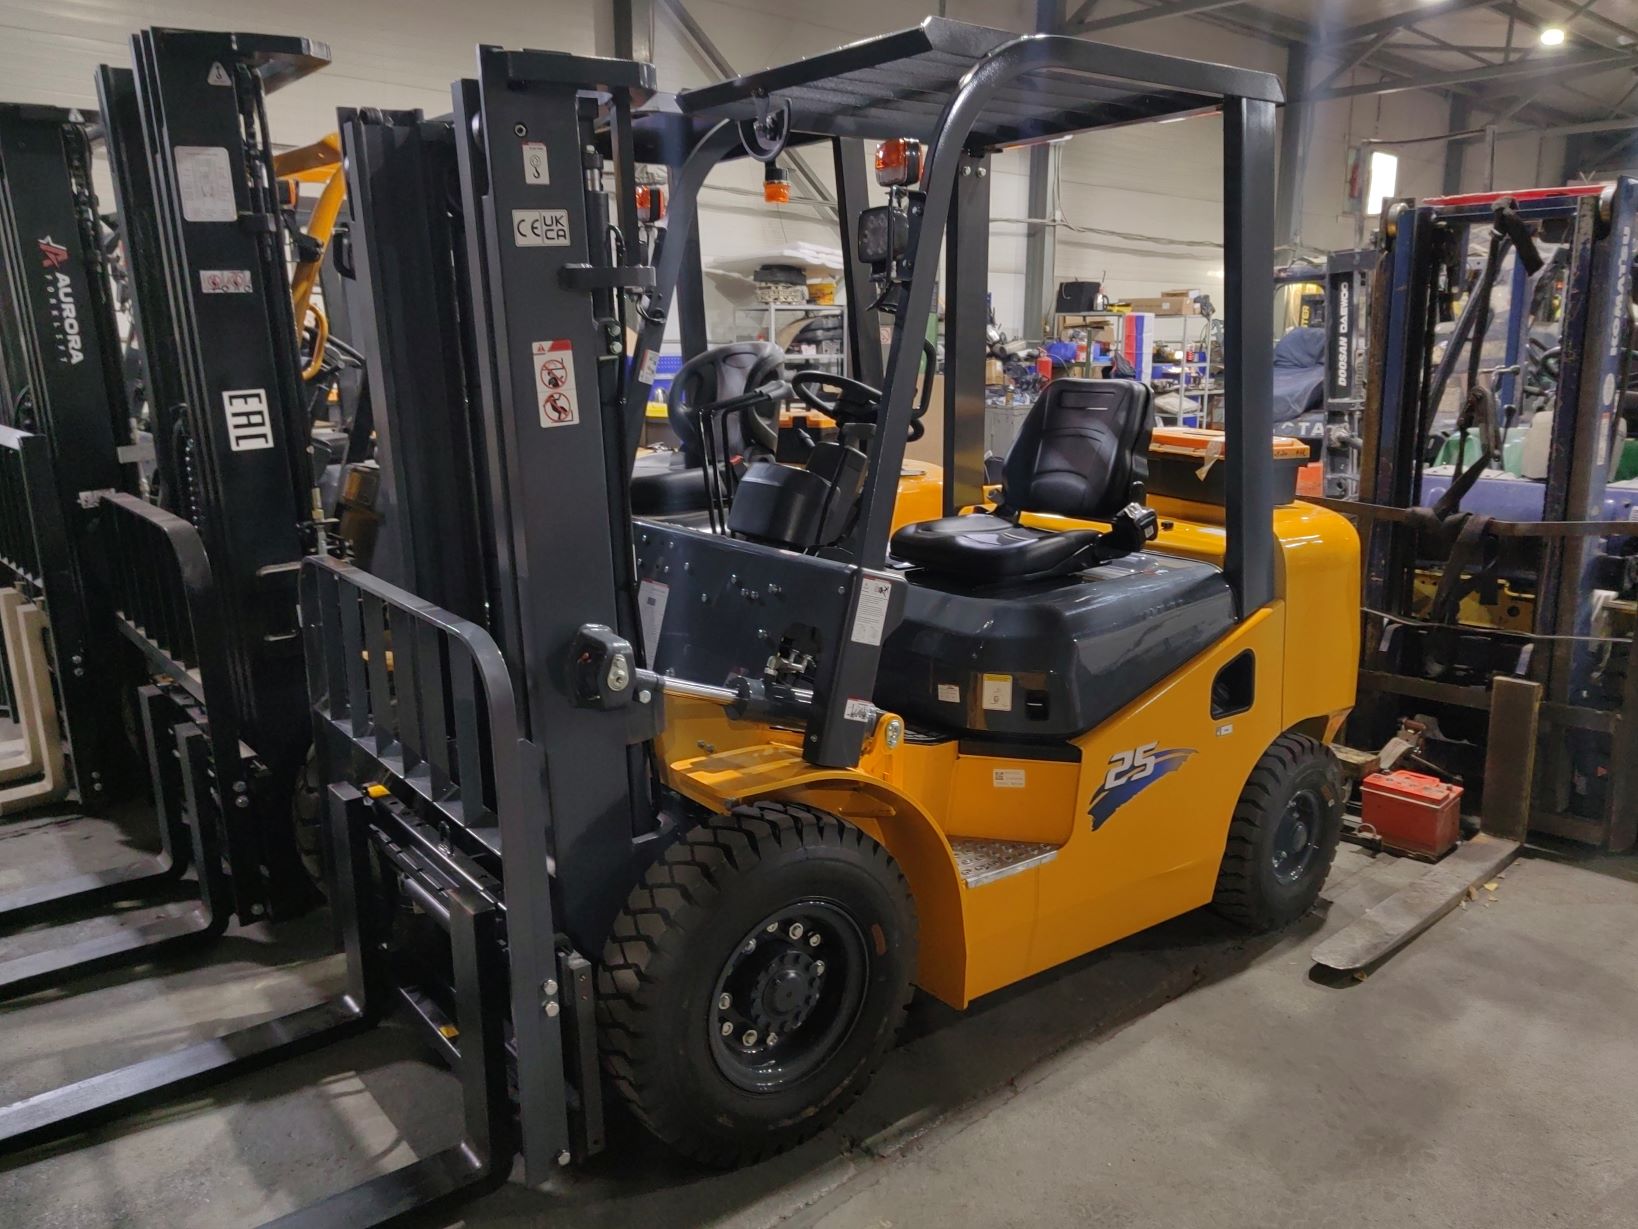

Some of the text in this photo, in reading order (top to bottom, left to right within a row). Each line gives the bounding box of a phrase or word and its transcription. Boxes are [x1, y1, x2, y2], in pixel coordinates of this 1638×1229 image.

[517, 219, 541, 237] CE
[543, 215, 565, 227] UK
[545, 229, 567, 240] CA
[1610, 226, 1631, 356] KOMATSU
[55, 271, 84, 365] AURORA
[1338, 281, 1349, 386] DOOSAN DAEWOO
[228, 393, 269, 447] EAC
[1104, 741, 1159, 790] 25
